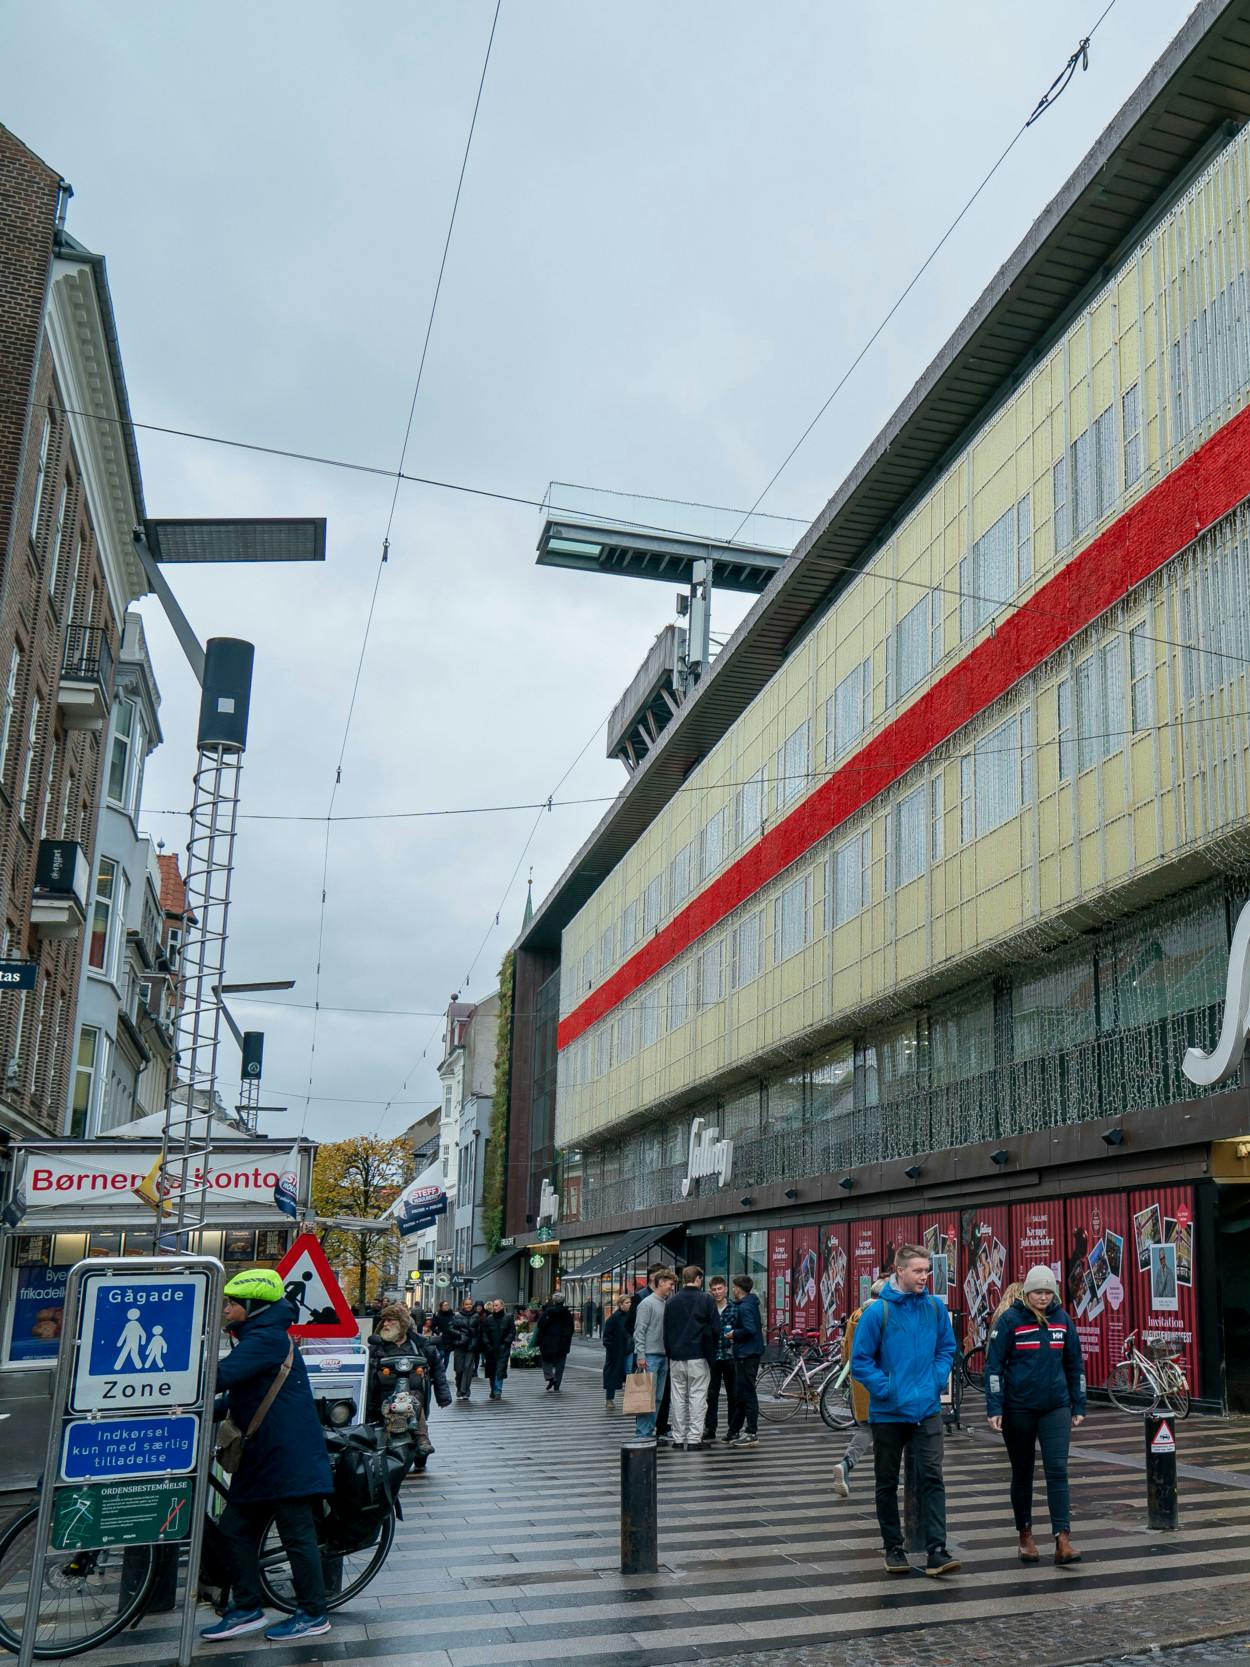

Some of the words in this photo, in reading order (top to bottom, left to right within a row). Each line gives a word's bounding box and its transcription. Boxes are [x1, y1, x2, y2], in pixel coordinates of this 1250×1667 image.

[681, 1117, 734, 1197] Salling
[108, 1288, 184, 1305] Gågade
[1147, 1315, 1184, 1328] Invitation
[101, 1381, 172, 1399] Zone
[97, 1426, 169, 1441] Indkørsel
[72, 1445, 99, 1456] kun
[106, 1441, 137, 1453] med
[143, 1439, 189, 1451] særlig
[95, 1454, 167, 1468] tilladelse
[101, 1481, 188, 1495] ORDENSBESTEMMELSE
